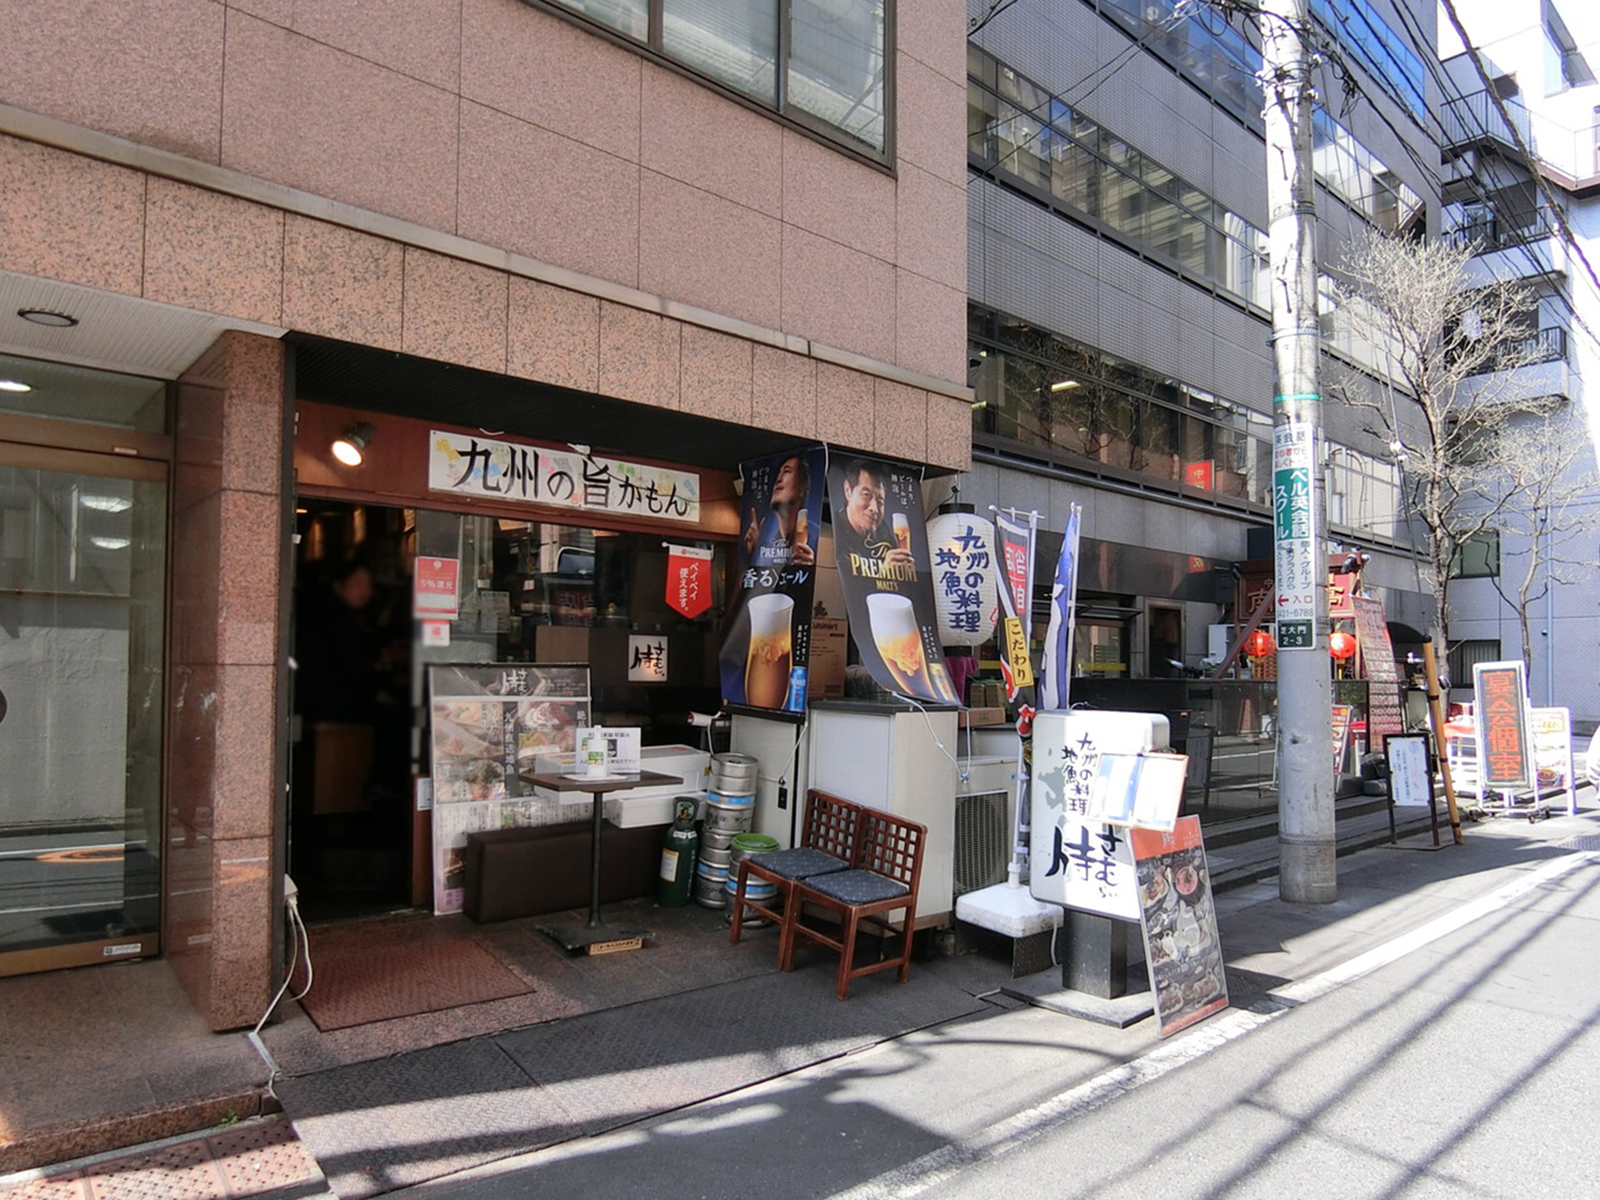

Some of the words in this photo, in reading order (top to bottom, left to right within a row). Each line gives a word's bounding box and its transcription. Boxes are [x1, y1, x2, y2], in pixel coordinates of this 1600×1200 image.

[453, 439, 688, 516] 九州の旨かもん
[1277, 486, 1289, 539] スクール
[849, 553, 918, 582] PREMIUM
[952, 525, 990, 589] 九州の
[679, 567, 689, 611] 使えます。
[690, 562, 699, 600] ペイペイ
[876, 579, 899, 592] MALT'S
[1293, 595, 1313, 604] 入口
[1011, 623, 1026, 681] こだわり
[1283, 637, 1302, 645] 2-3
